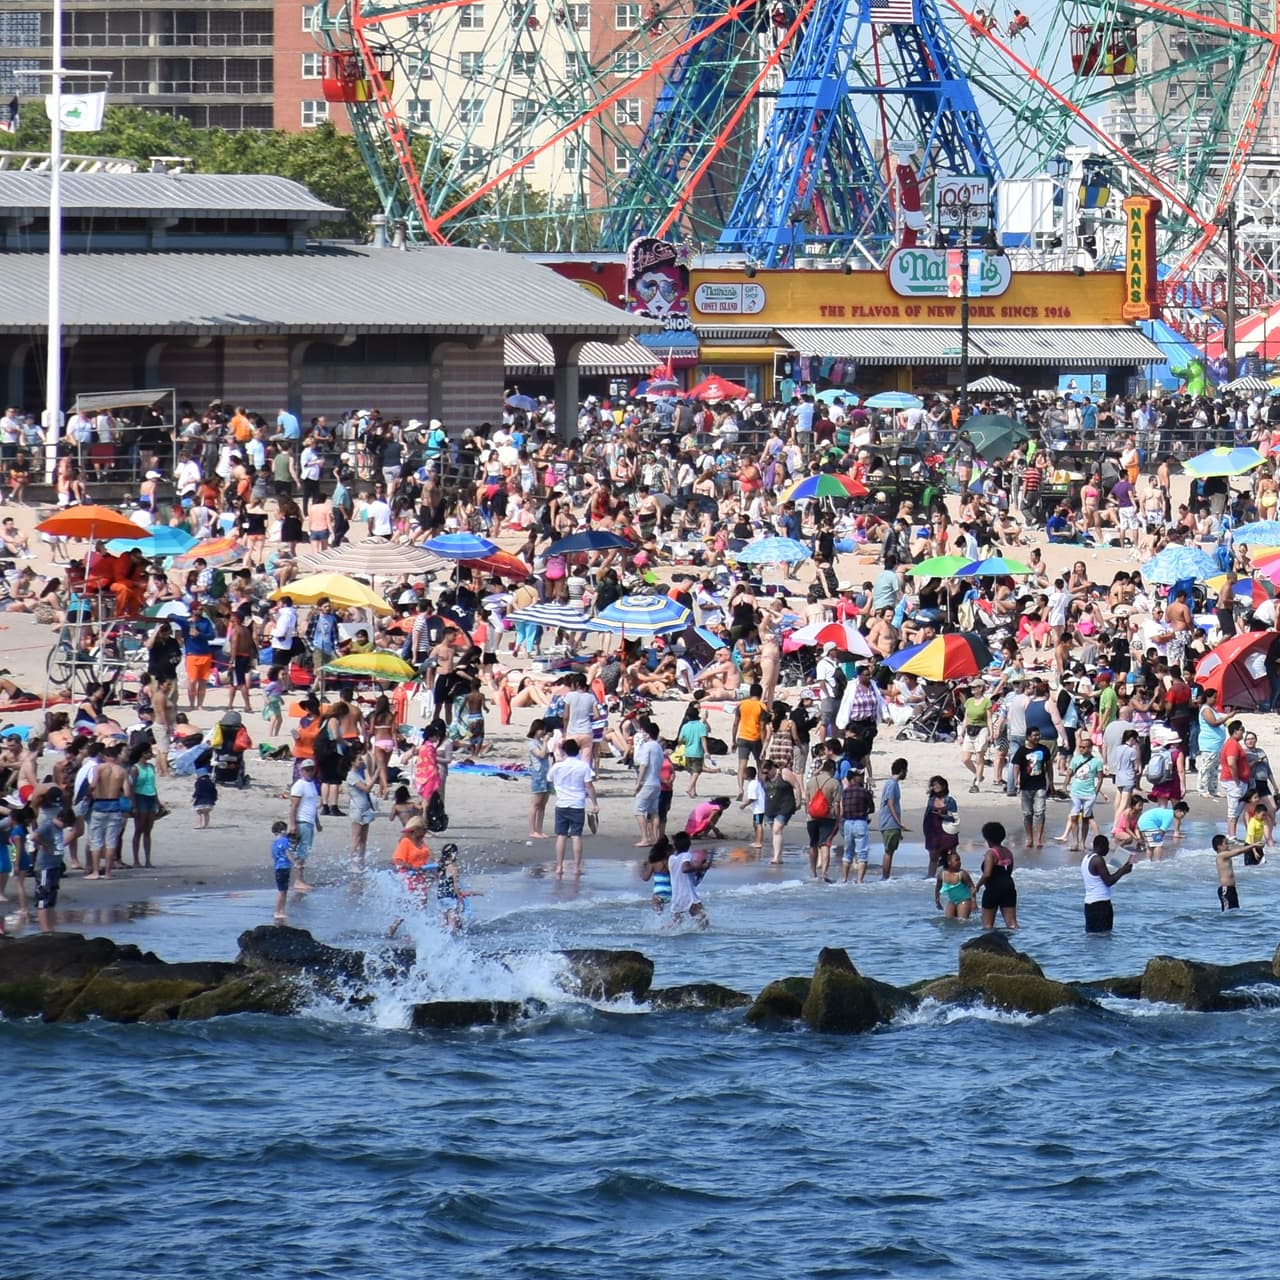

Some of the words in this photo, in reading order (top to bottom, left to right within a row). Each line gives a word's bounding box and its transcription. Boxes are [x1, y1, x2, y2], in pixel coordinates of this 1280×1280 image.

[1130, 207, 1142, 303] NATHANS
[899, 252, 1001, 285] Nat's
[820, 305, 845, 317] THE
[851, 305, 900, 318] FLAVOR
[905, 305, 921, 318] OF
[927, 305, 956, 318] NEW
[968, 306, 996, 318] ORK
[1001, 306, 1039, 318] SINCE
[1044, 306, 1072, 319] 1916
[664, 319, 690, 330] SHOP
